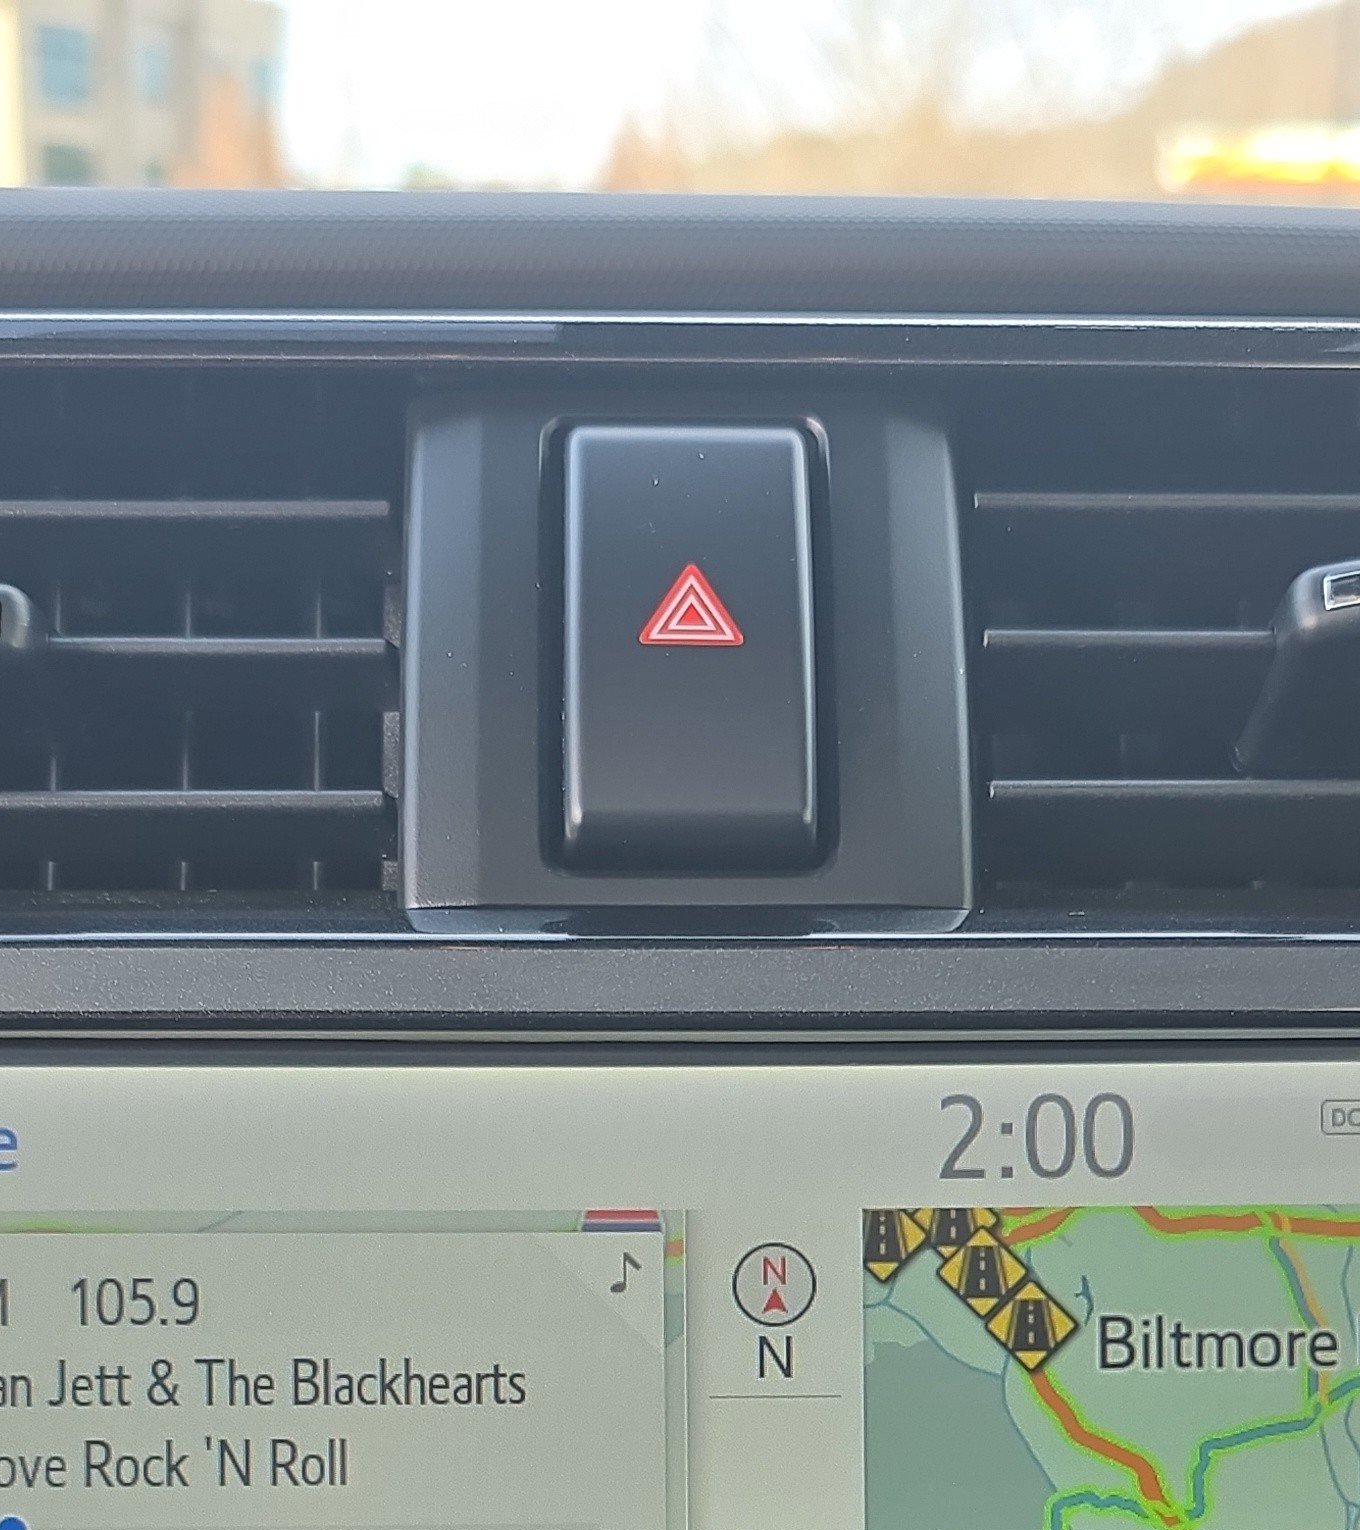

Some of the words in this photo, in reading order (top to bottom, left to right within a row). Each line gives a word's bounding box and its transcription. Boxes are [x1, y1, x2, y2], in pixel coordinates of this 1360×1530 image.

[938, 1093, 1135, 1181] 2:00
[763, 1256, 787, 1285] N
[71, 1278, 201, 1326] 105.9
[759, 1336, 793, 1378] N
[1098, 1313, 1340, 1371] Biltmore
[47, 1359, 131, 1407] Jett
[147, 1360, 180, 1407] &
[194, 1359, 277, 1407] The
[292, 1357, 527, 1406] Blackhearts
[83, 1439, 190, 1488] Rock
[204, 1437, 251, 1487] 'N
[268, 1437, 349, 1487] Roll
